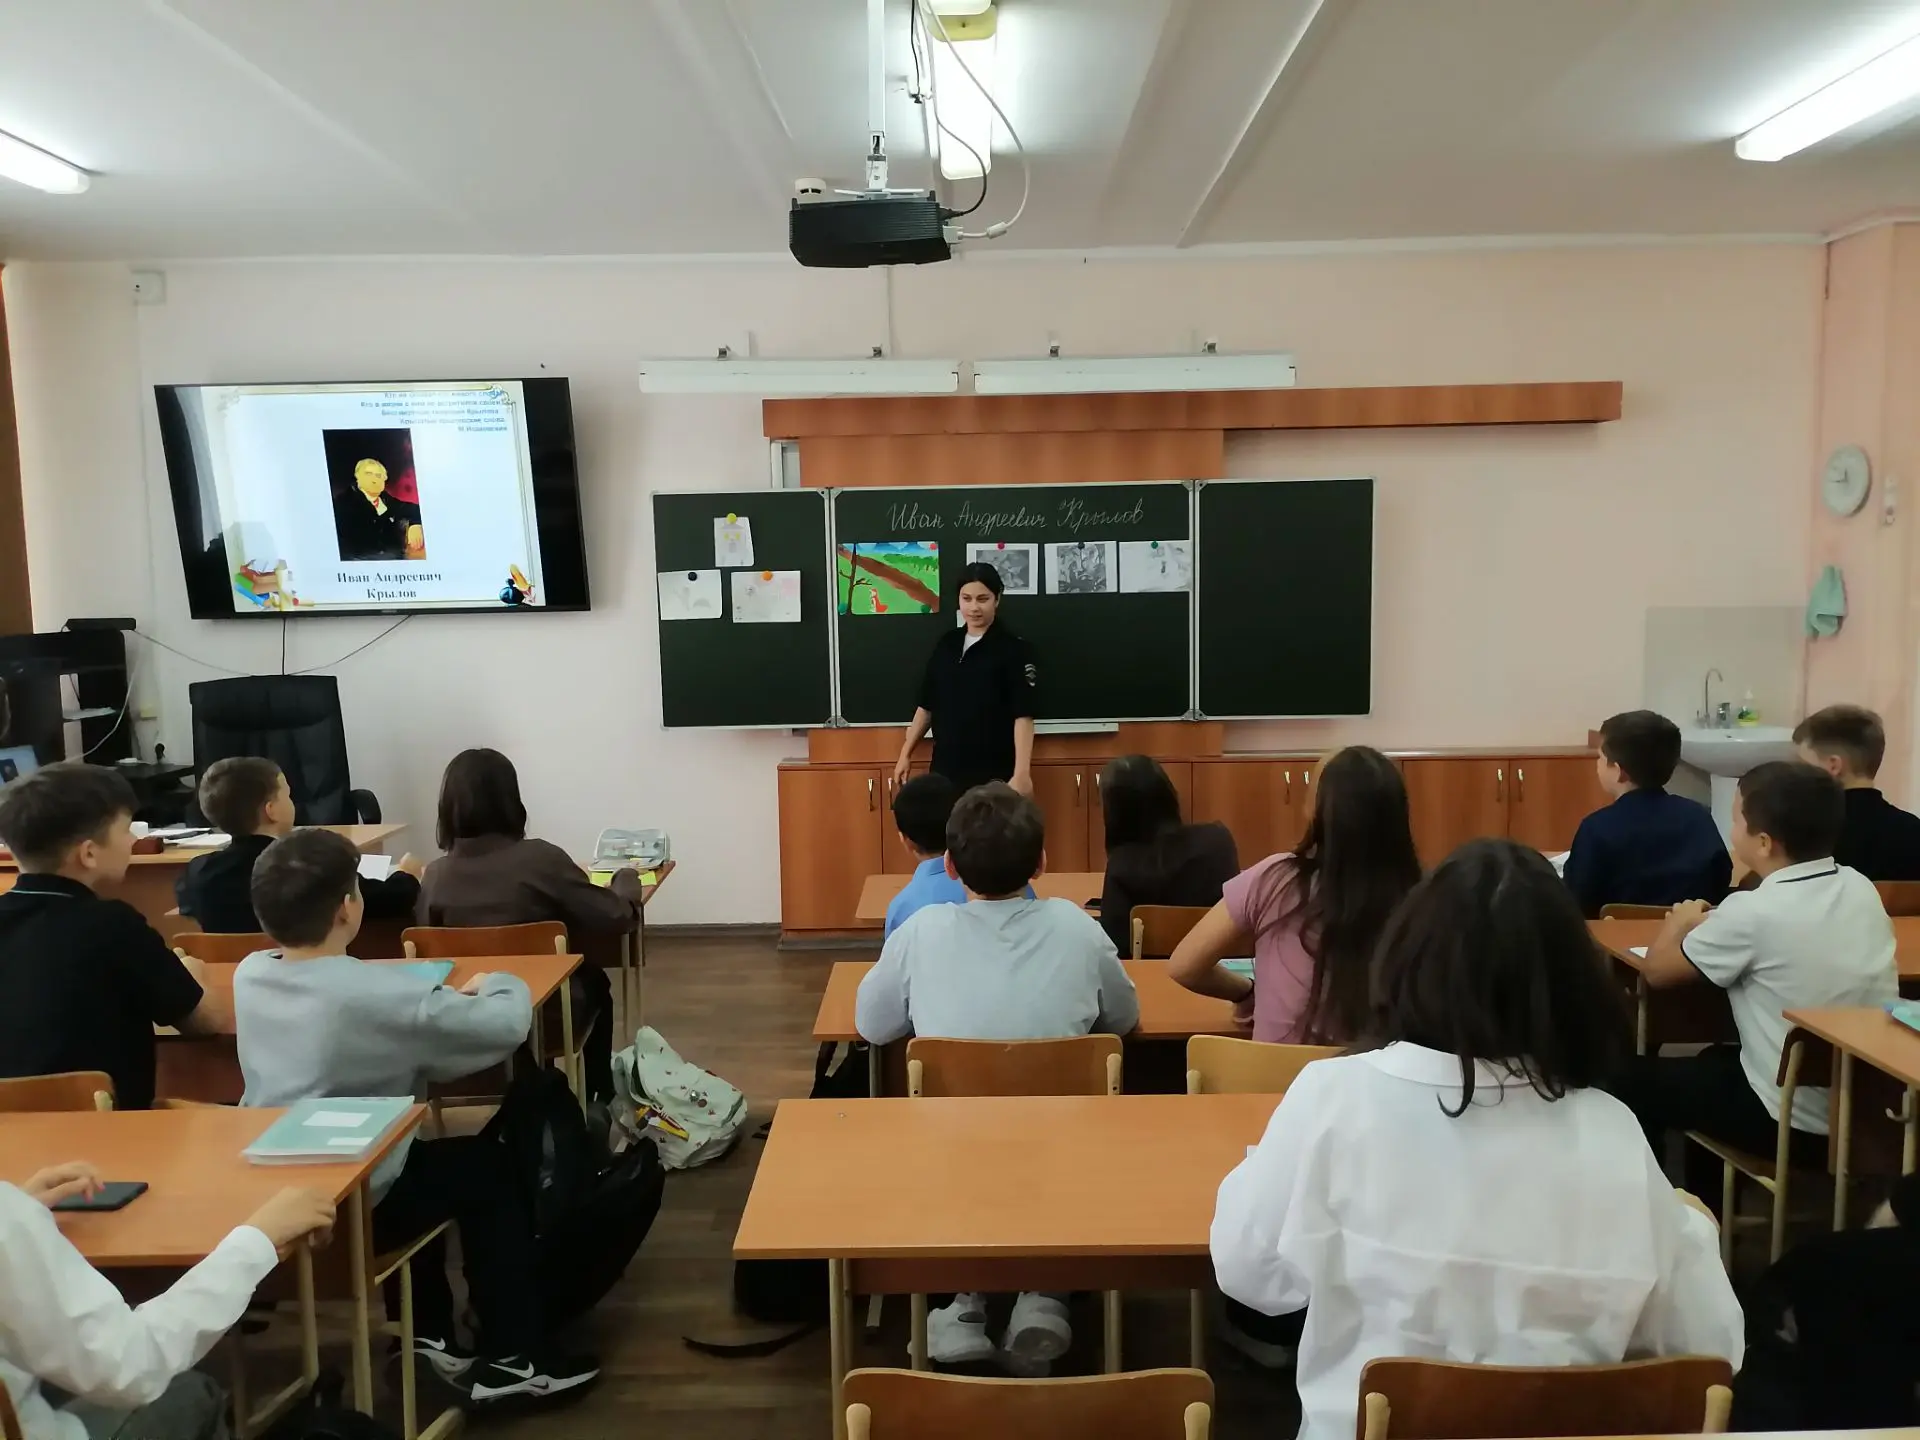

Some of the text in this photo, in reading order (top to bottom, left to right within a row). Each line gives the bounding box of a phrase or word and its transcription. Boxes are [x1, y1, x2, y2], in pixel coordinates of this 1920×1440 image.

[887, 497, 1144, 536] Иван Андреевич Крылов
[337, 572, 442, 585] Иван Андреевич
[367, 588, 417, 601] Крылов
